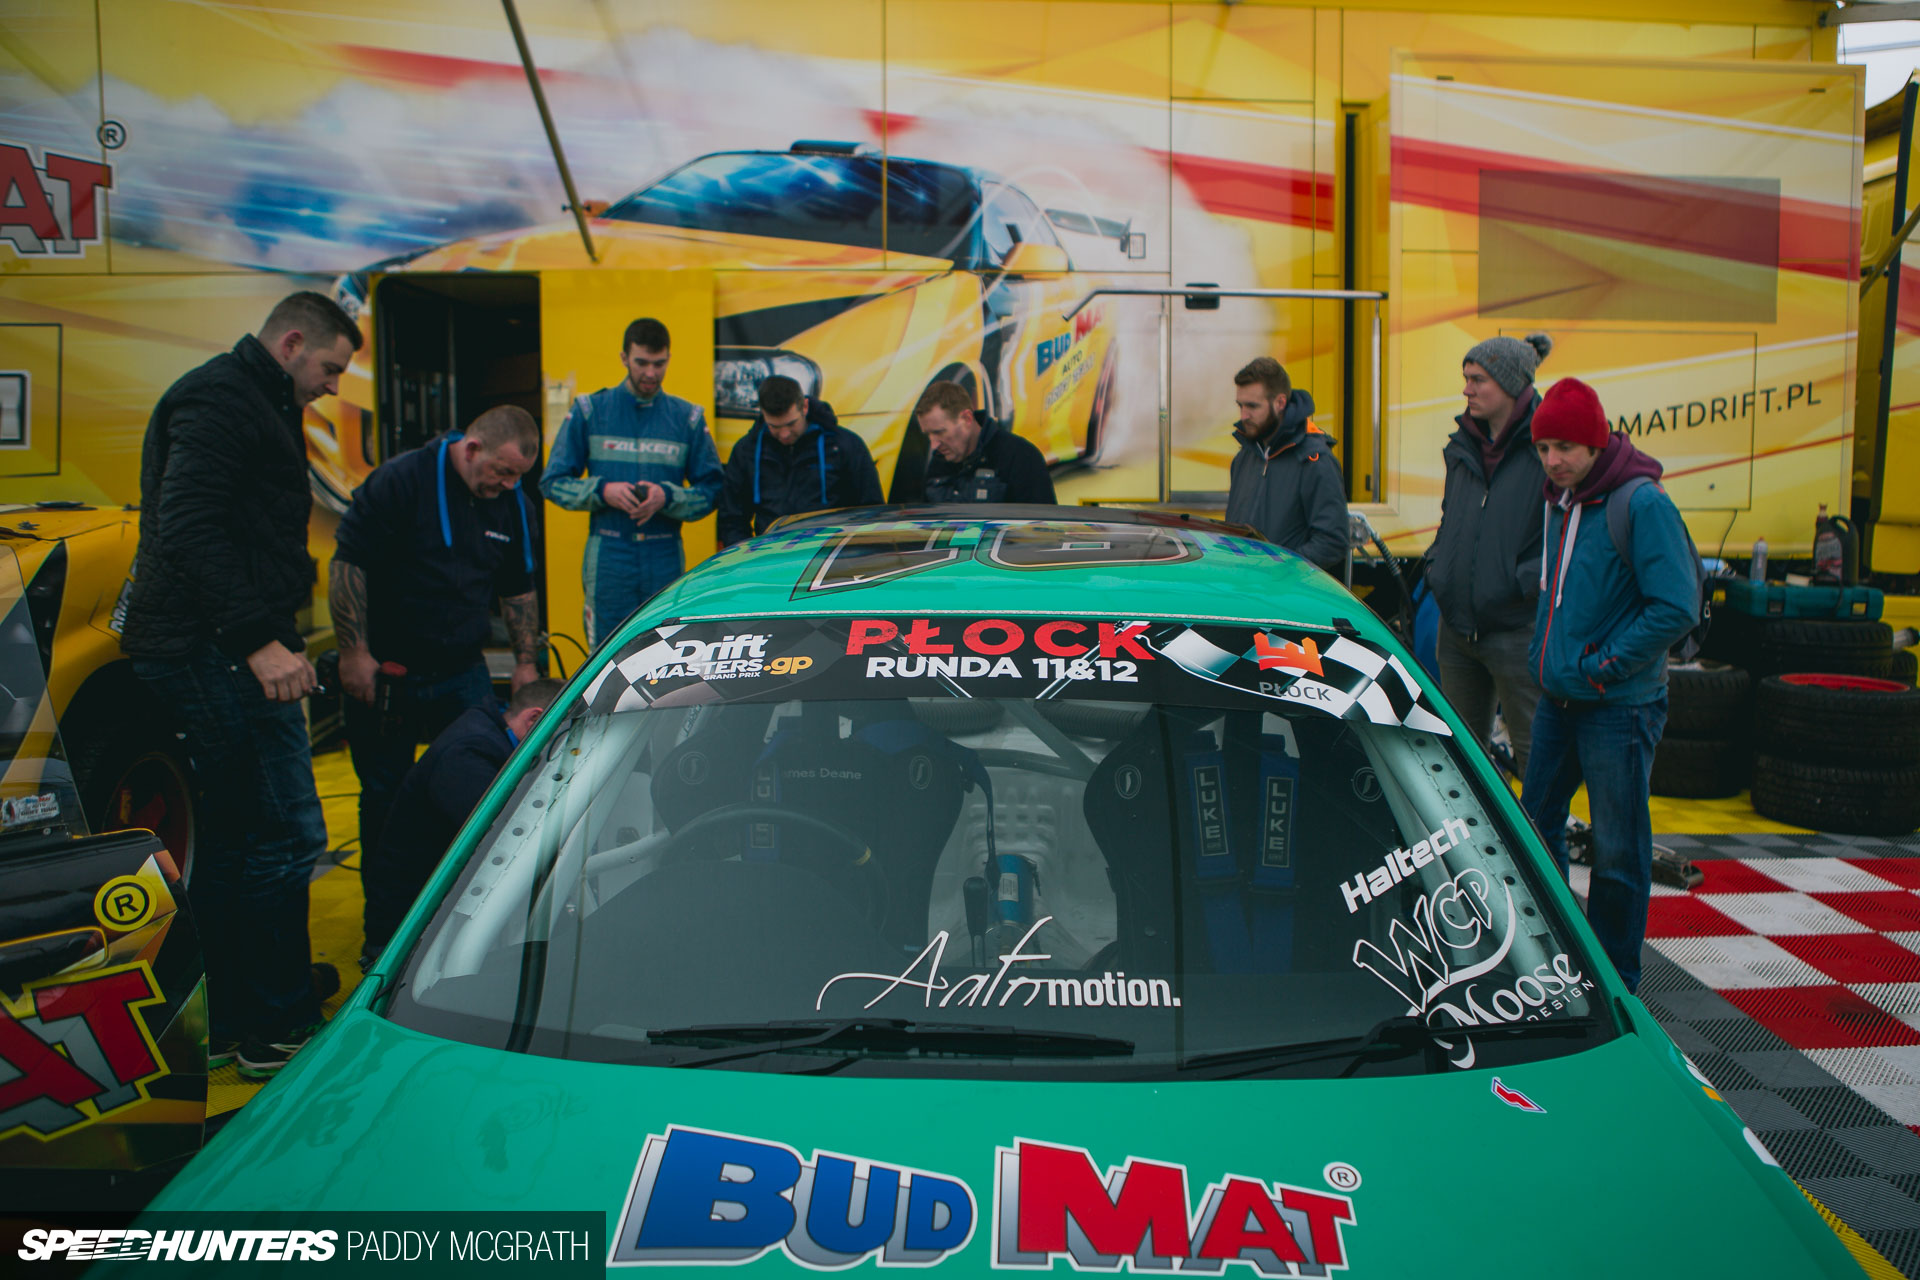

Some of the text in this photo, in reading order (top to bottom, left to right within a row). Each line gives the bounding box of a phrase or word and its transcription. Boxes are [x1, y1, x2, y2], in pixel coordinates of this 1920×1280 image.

[675, 633, 770, 664] Drift
[845, 618, 1157, 660] PŁOCK
[866, 656, 1139, 683] RUNDA 11&12
[703, 671, 761, 681] GRAND PRIX
[756, 766, 770, 833] LUE
[820, 767, 862, 780] Deane
[1199, 772, 1222, 840] LUKE
[1268, 782, 1288, 850] LUKE
[1340, 818, 1470, 914] Haltech
[1352, 867, 1493, 1014] WCP
[1425, 952, 1582, 1069] Moose
[608, 1123, 977, 1271] BUD
[992, 1137, 1357, 1278] MAT
